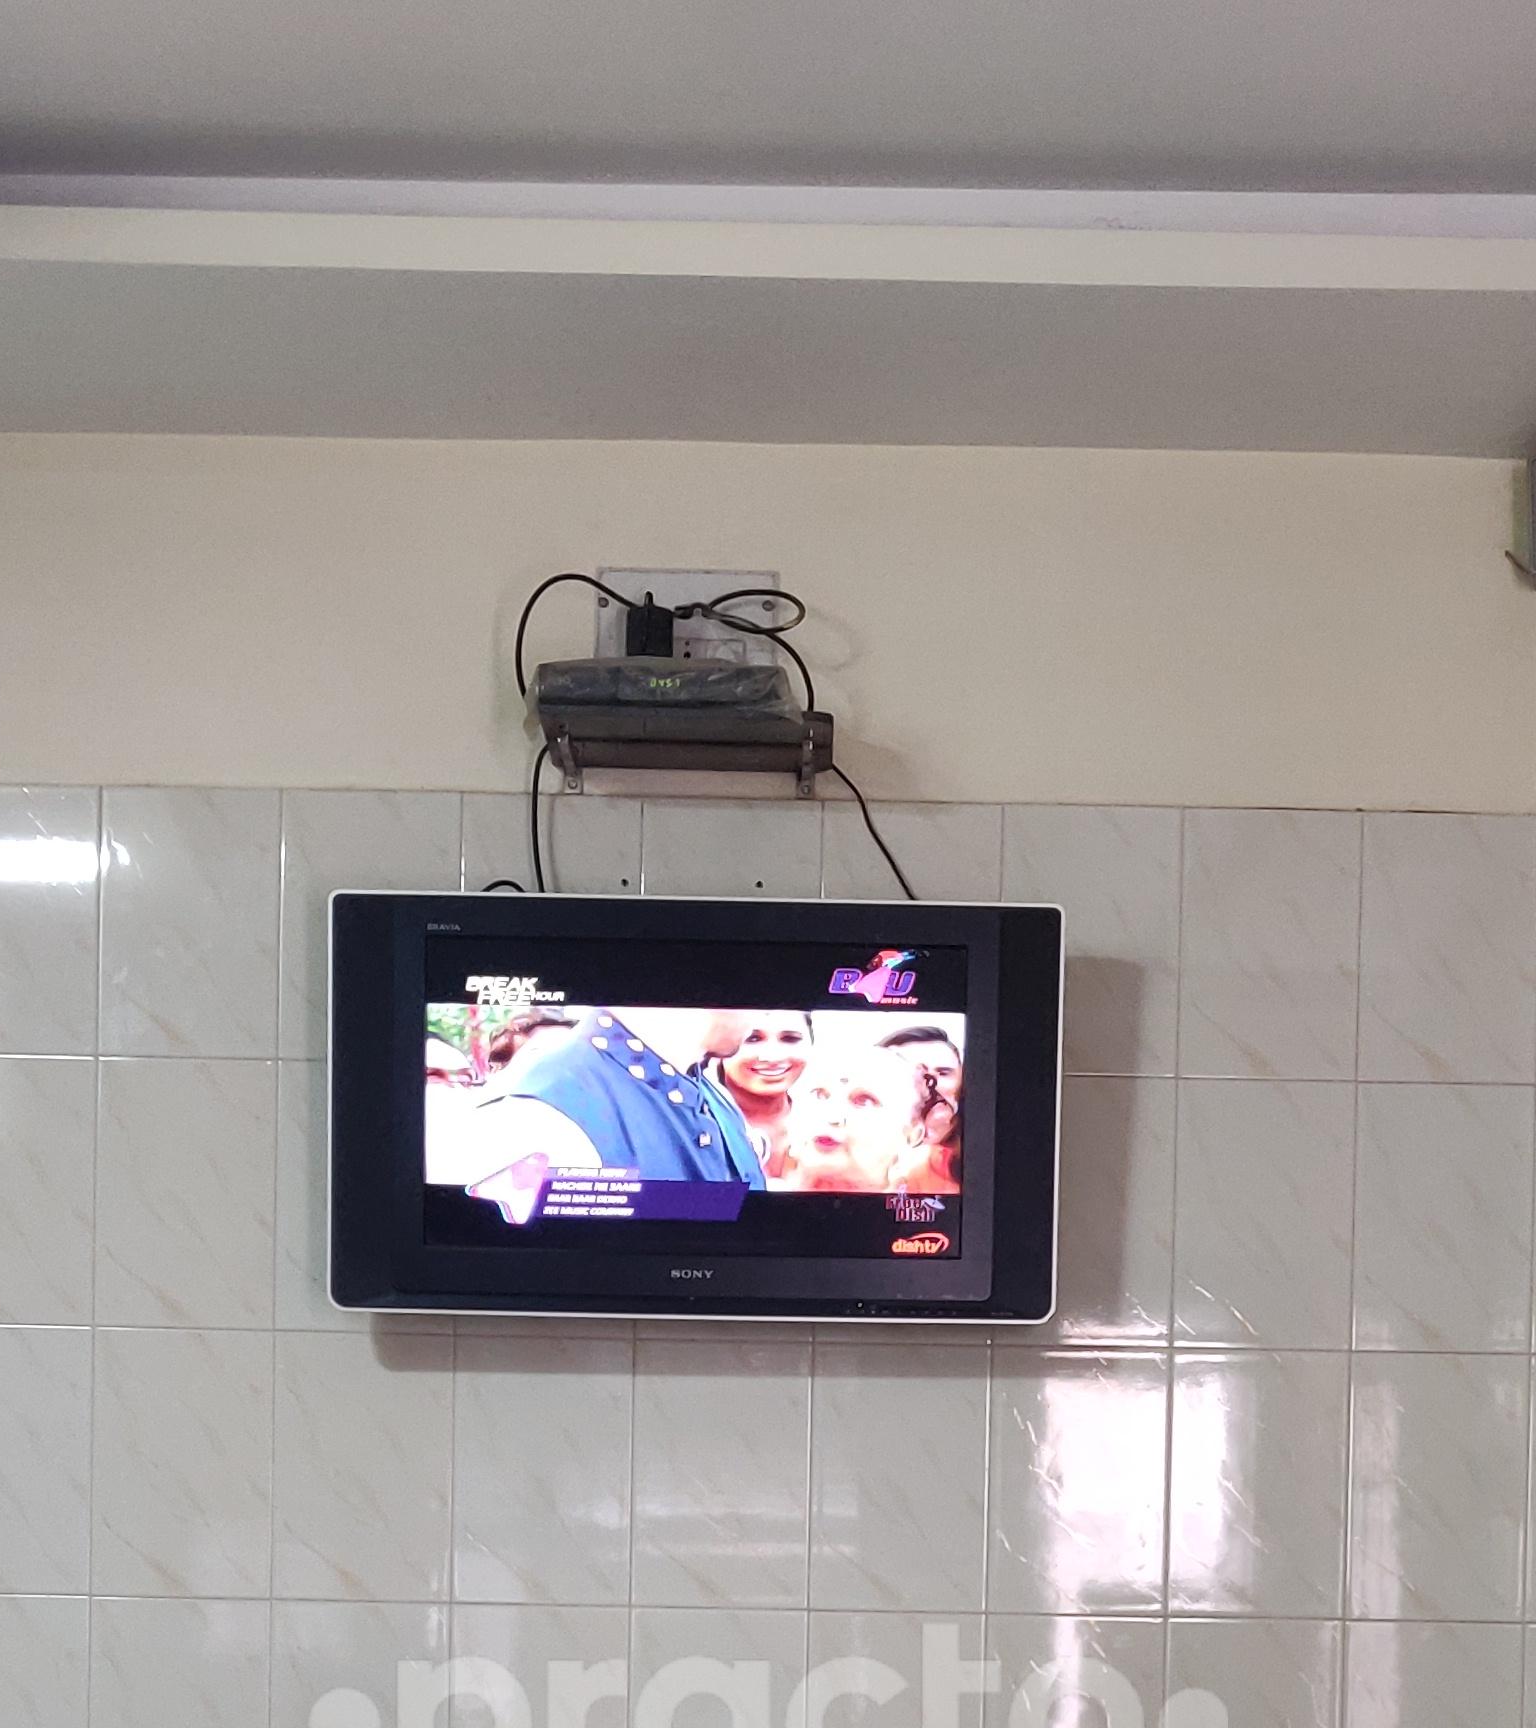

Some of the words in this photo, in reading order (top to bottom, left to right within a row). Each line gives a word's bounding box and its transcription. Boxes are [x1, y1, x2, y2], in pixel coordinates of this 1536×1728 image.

[465, 975, 539, 993] BREAK
[531, 991, 565, 1002] HOUR
[670, 1269, 714, 1279] SONY
